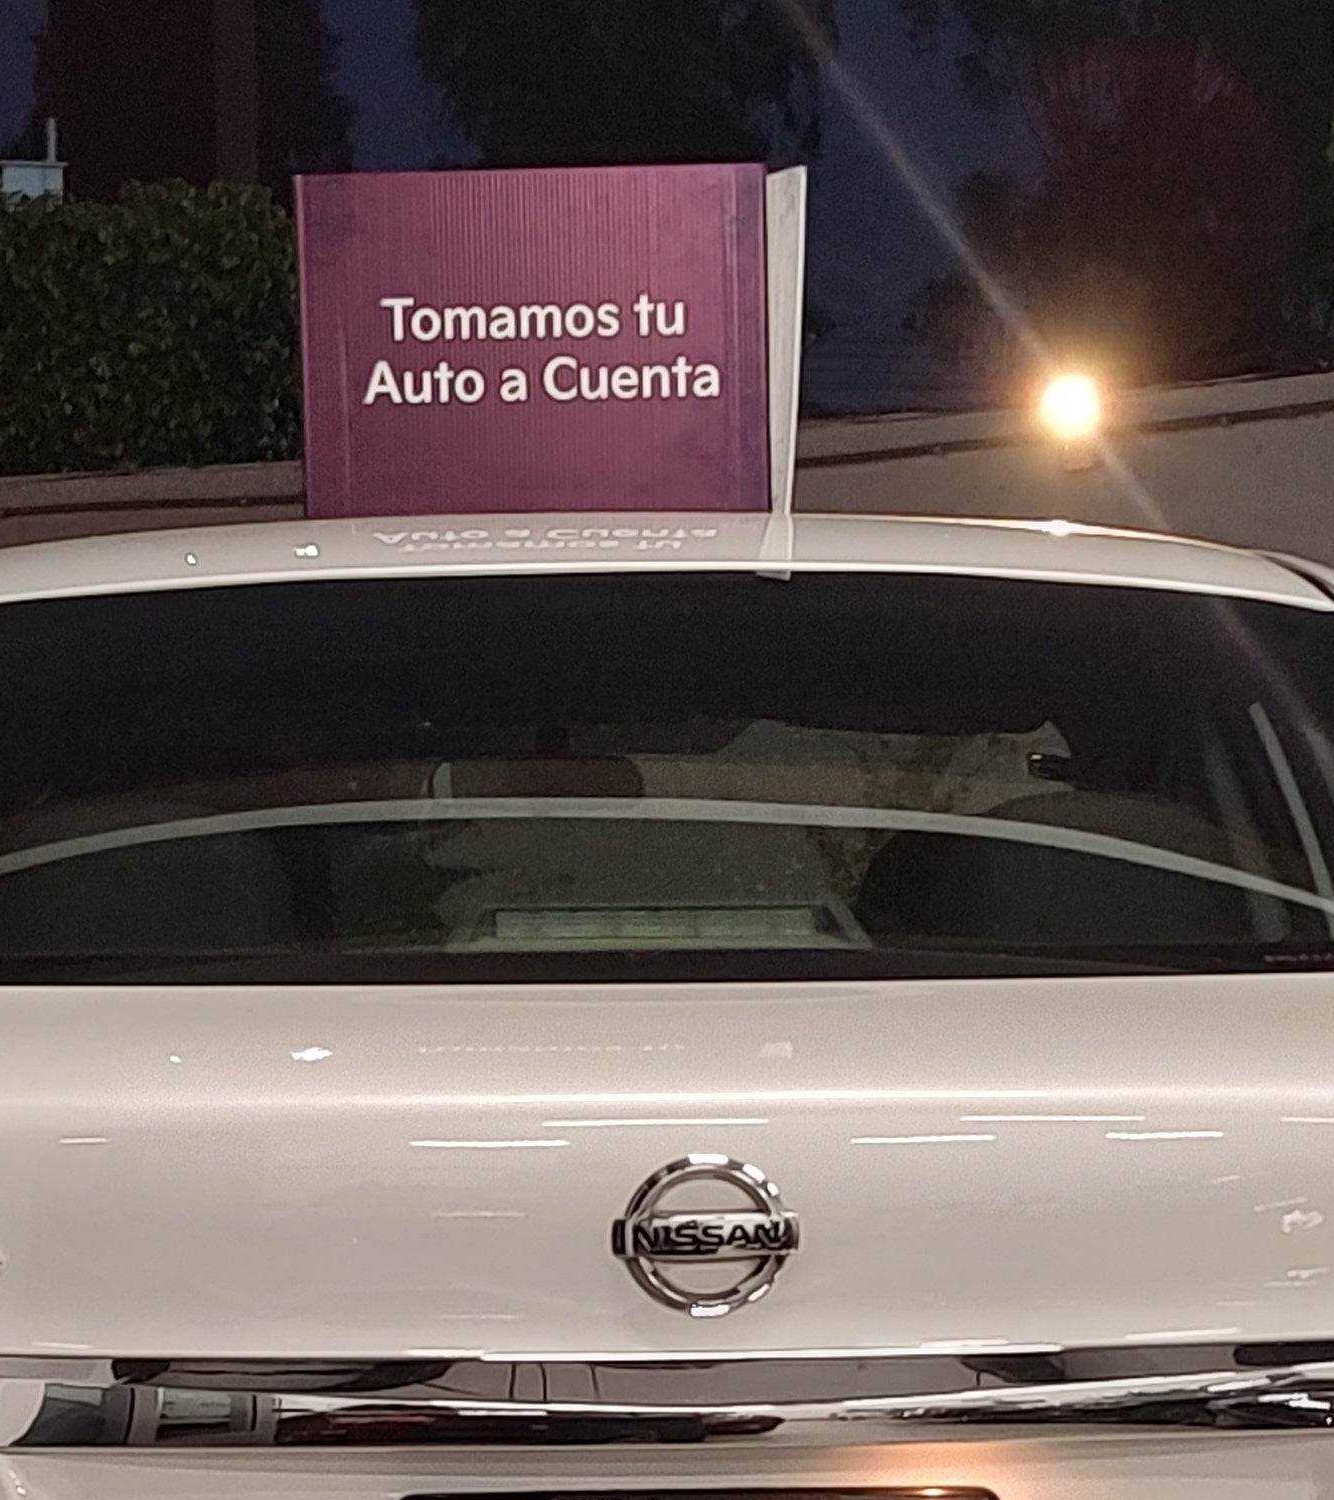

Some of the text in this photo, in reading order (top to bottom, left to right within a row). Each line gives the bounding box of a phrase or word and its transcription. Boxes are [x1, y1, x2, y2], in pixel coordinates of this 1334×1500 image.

[380, 292, 685, 343] Tomamos tu
[363, 355, 721, 405] Auto a Cuenta
[632, 1220, 786, 1250] NISSAN
